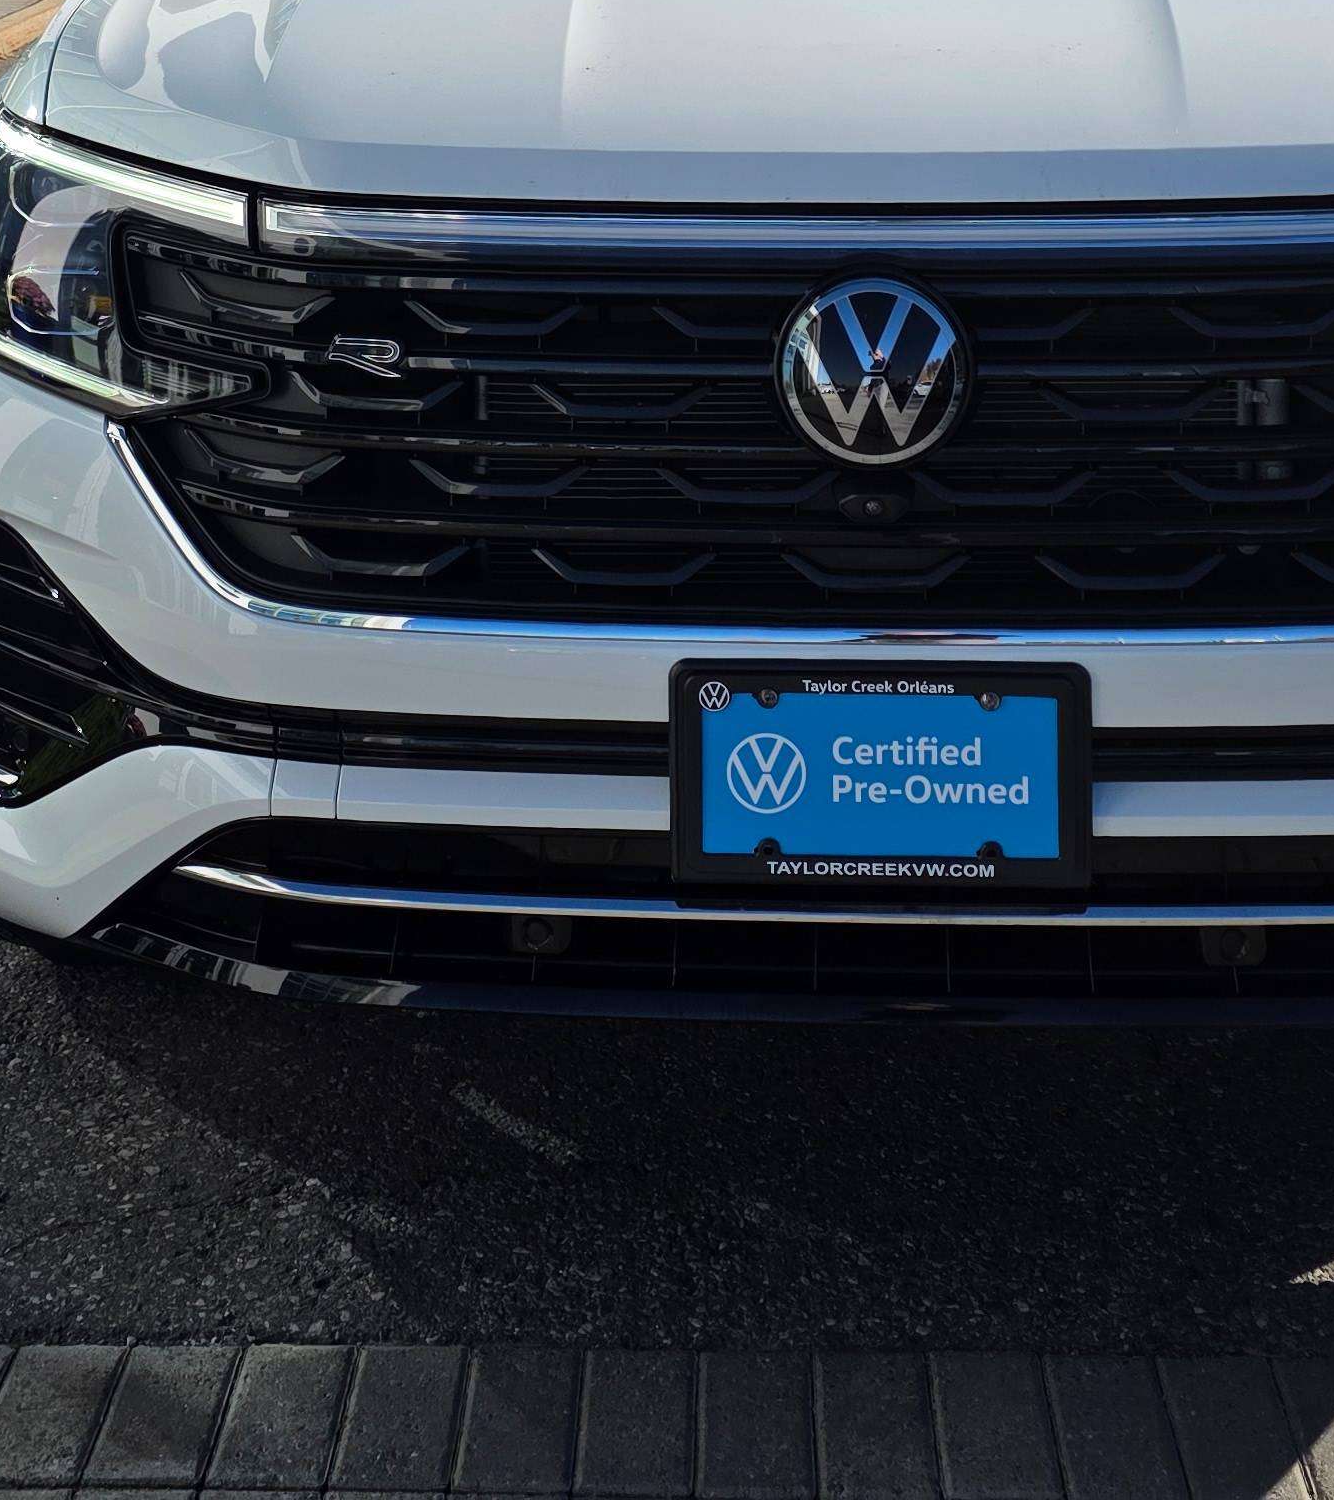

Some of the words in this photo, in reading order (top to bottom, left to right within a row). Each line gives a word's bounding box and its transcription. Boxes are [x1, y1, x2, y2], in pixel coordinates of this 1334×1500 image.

[802, 679, 848, 694] Taylor
[851, 680, 893, 693] Creek
[897, 680, 955, 694] Orléans
[832, 736, 981, 766] Certified
[832, 775, 1030, 805] Pre-Owned
[766, 861, 995, 878] TAYLORCREEKVW.COM
